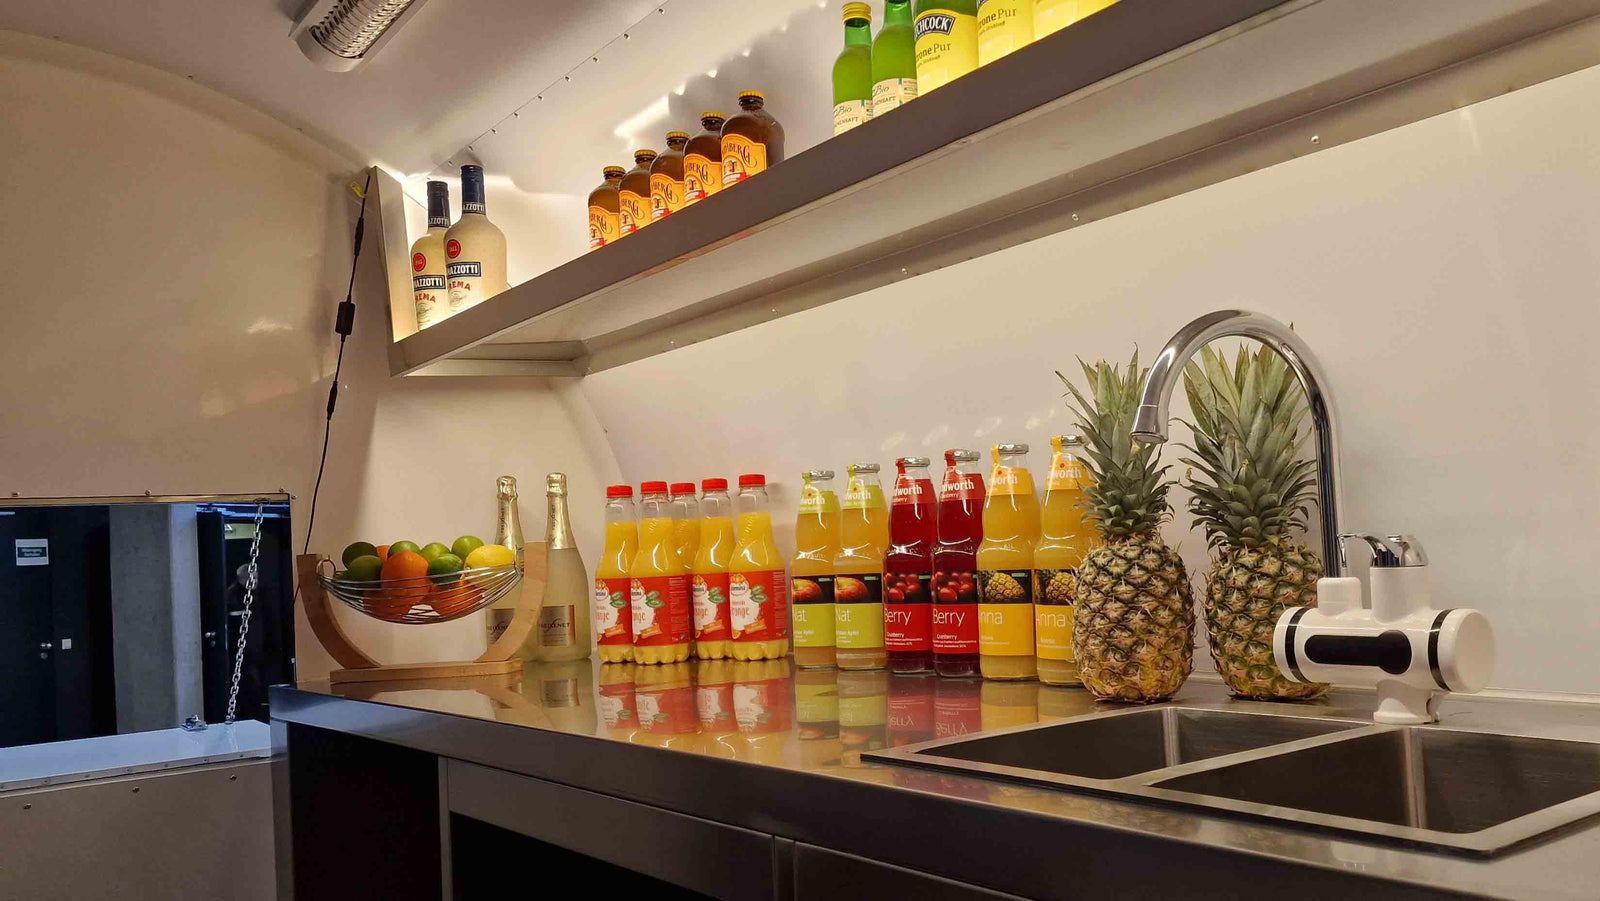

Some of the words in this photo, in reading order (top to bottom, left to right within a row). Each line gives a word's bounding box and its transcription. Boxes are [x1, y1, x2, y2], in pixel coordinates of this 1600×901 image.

[998, 8, 1017, 20] Pur
[934, 42, 952, 54] Pur
[884, 607, 911, 626] Berry
[933, 608, 965, 627] Berry
